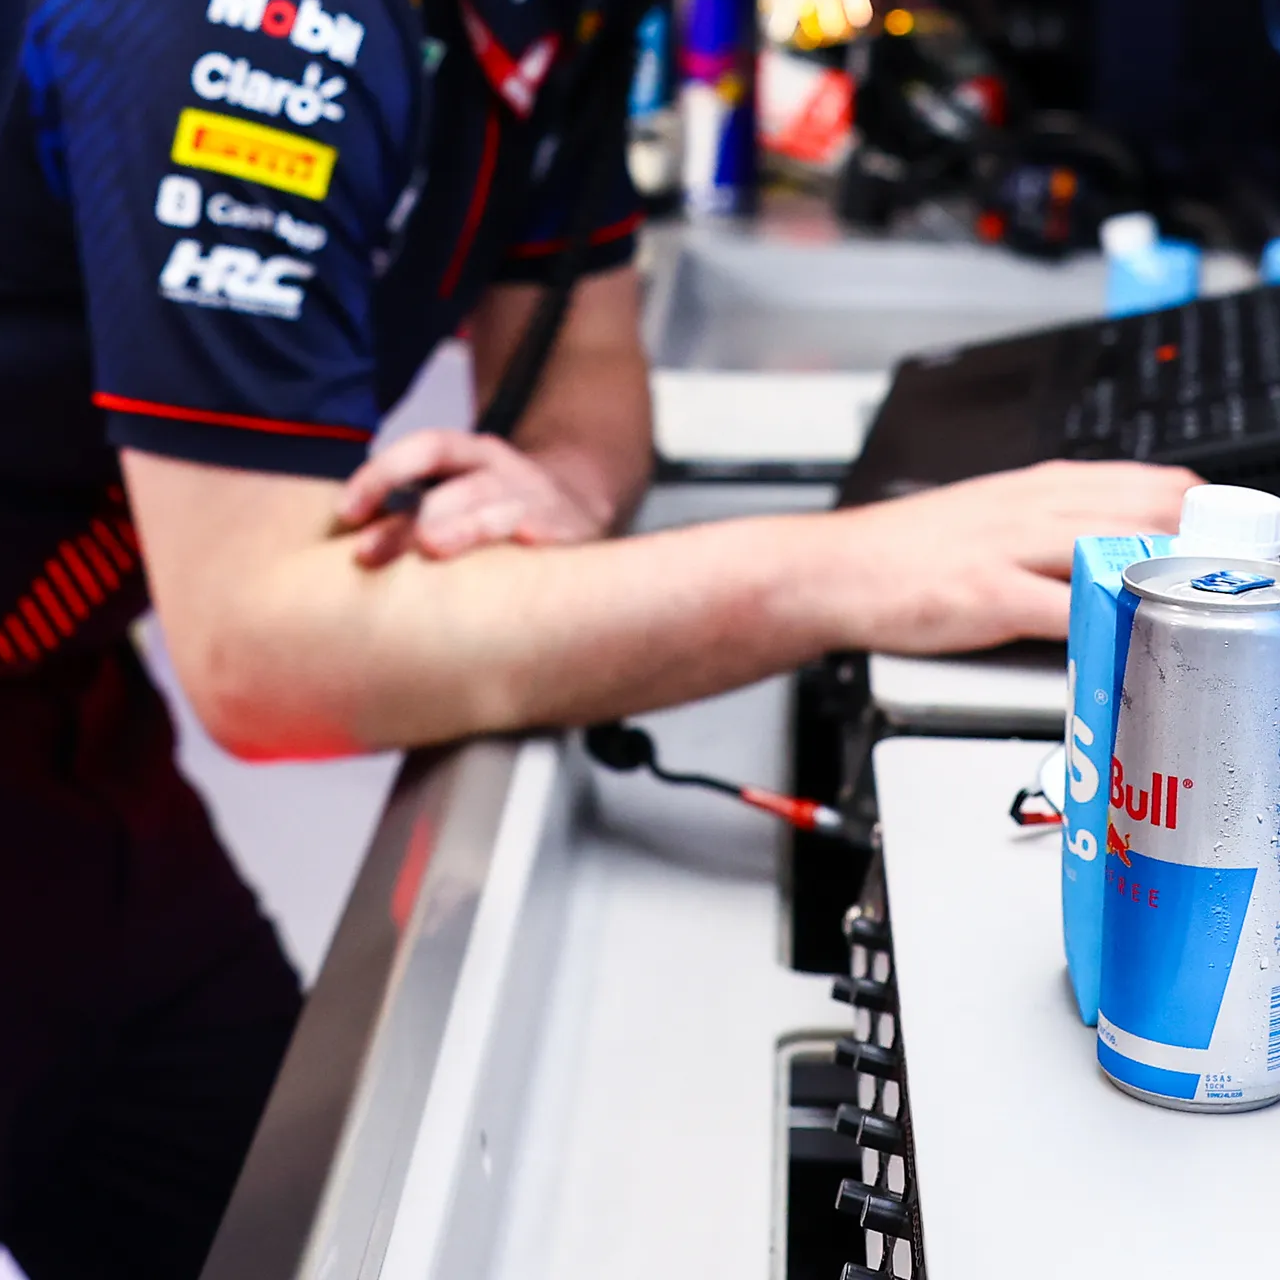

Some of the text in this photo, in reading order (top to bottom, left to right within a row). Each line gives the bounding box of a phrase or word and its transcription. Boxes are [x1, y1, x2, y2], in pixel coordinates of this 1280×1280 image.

[192, 52, 326, 125] Claro
[160, 238, 316, 312] HRC
[1110, 753, 1178, 829] Bull
